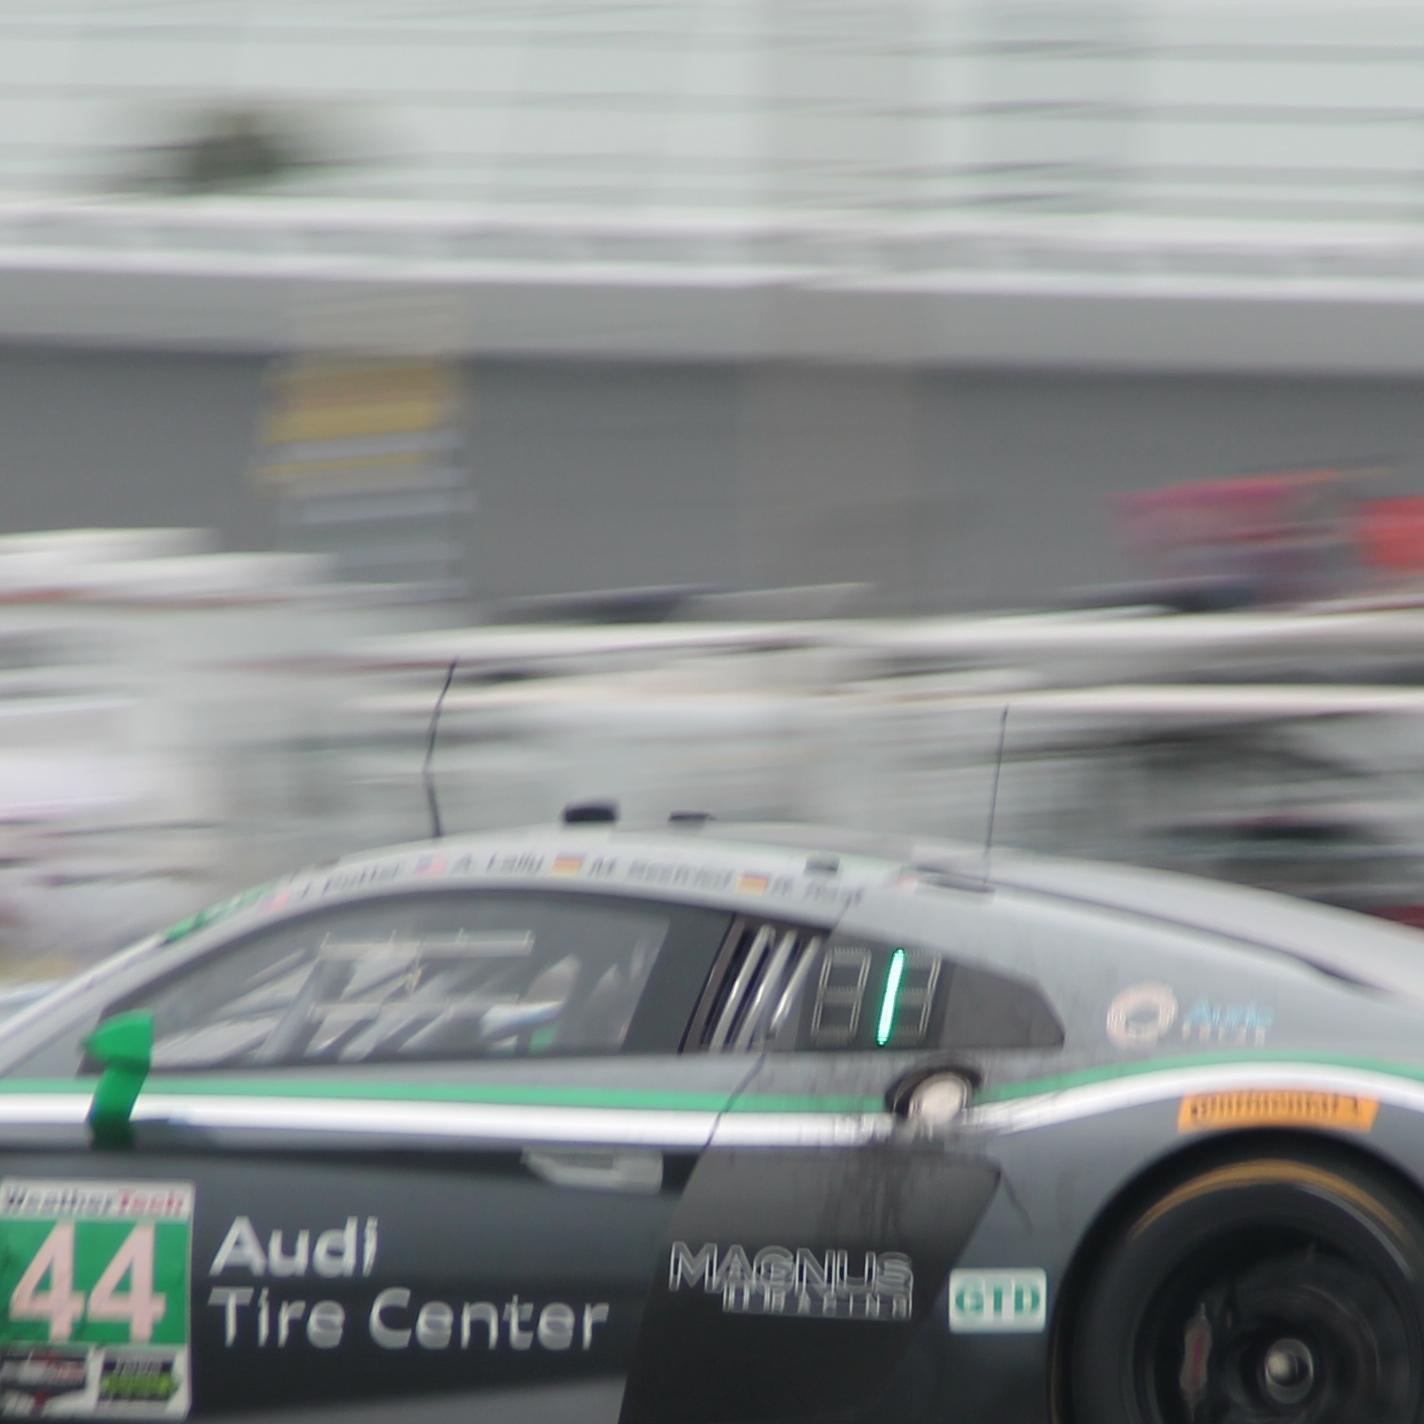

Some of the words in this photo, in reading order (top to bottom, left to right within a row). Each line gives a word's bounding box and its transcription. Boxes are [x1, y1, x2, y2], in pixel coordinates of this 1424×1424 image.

[208, 1214, 379, 1278] Audi
[669, 1240, 914, 1299] MAGNUS
[9, 1216, 168, 1345] 44
[955, 1274, 1041, 1321] GTD
[207, 1286, 346, 1349] Tire
[369, 1286, 611, 1351] Center
